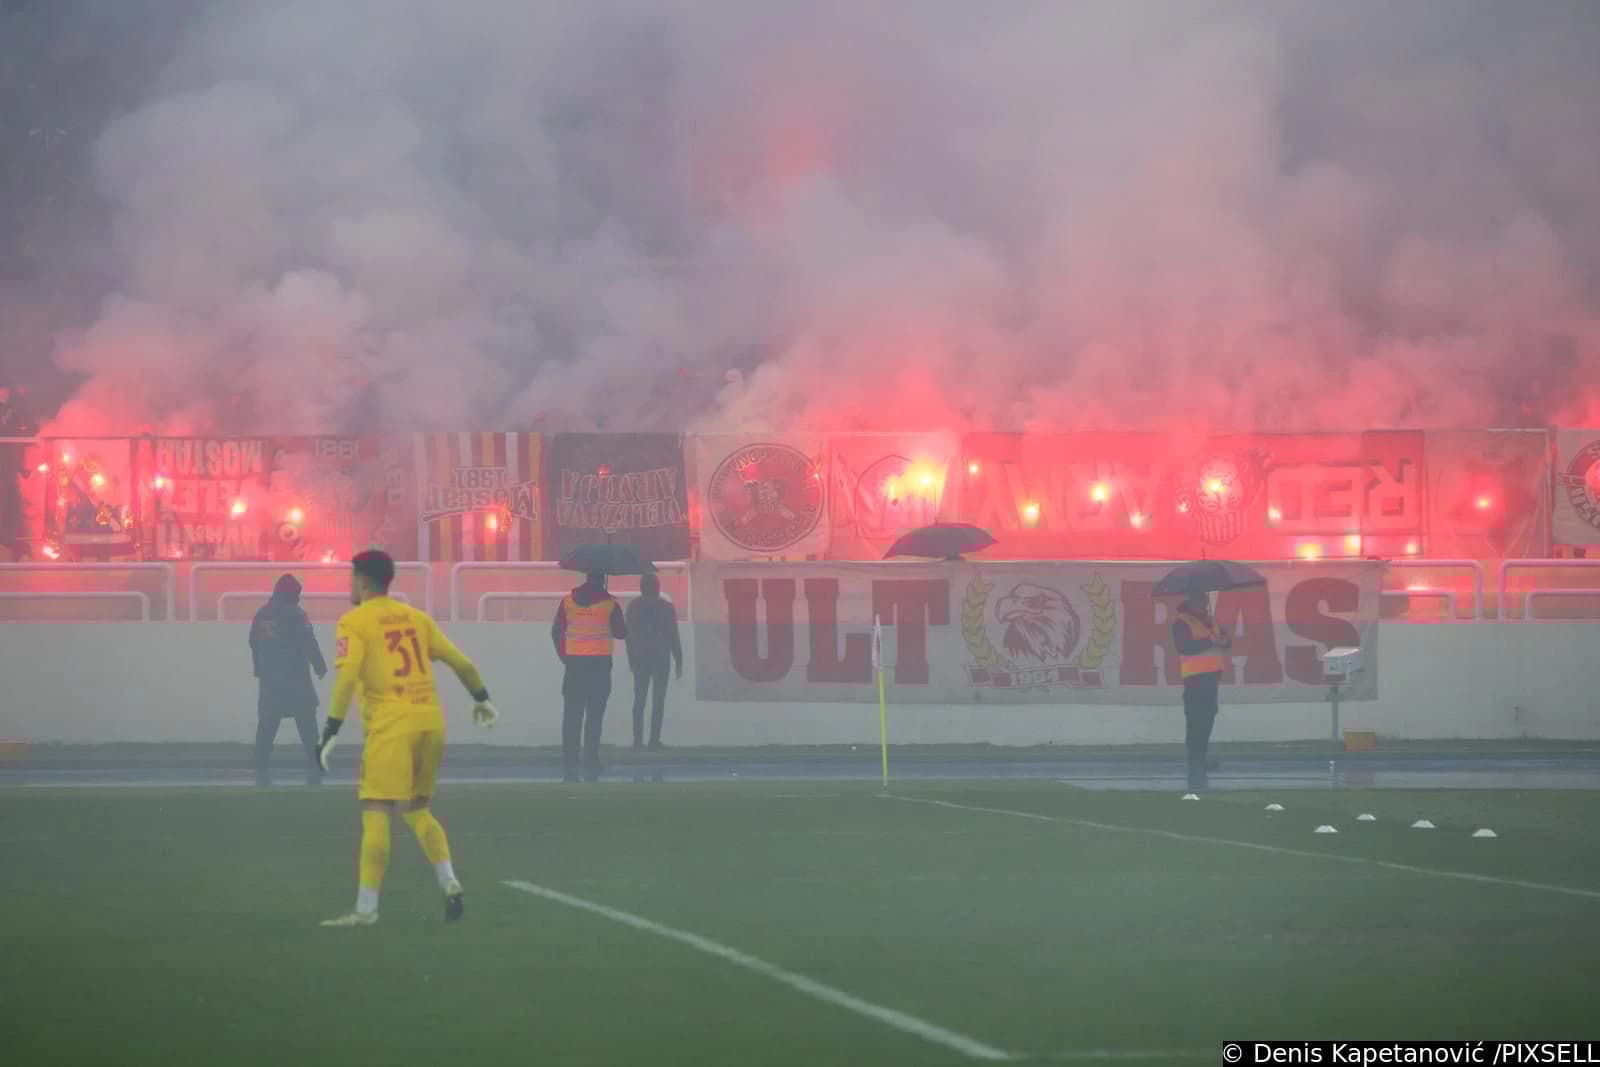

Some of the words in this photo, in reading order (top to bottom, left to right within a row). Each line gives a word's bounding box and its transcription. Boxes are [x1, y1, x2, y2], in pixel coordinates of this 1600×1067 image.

[156, 440, 262, 475] MOSTAR
[456, 467, 505, 488] 1981
[1267, 461, 1416, 531] RED
[384, 628, 426, 677] 31
[723, 578, 949, 684] ULT
